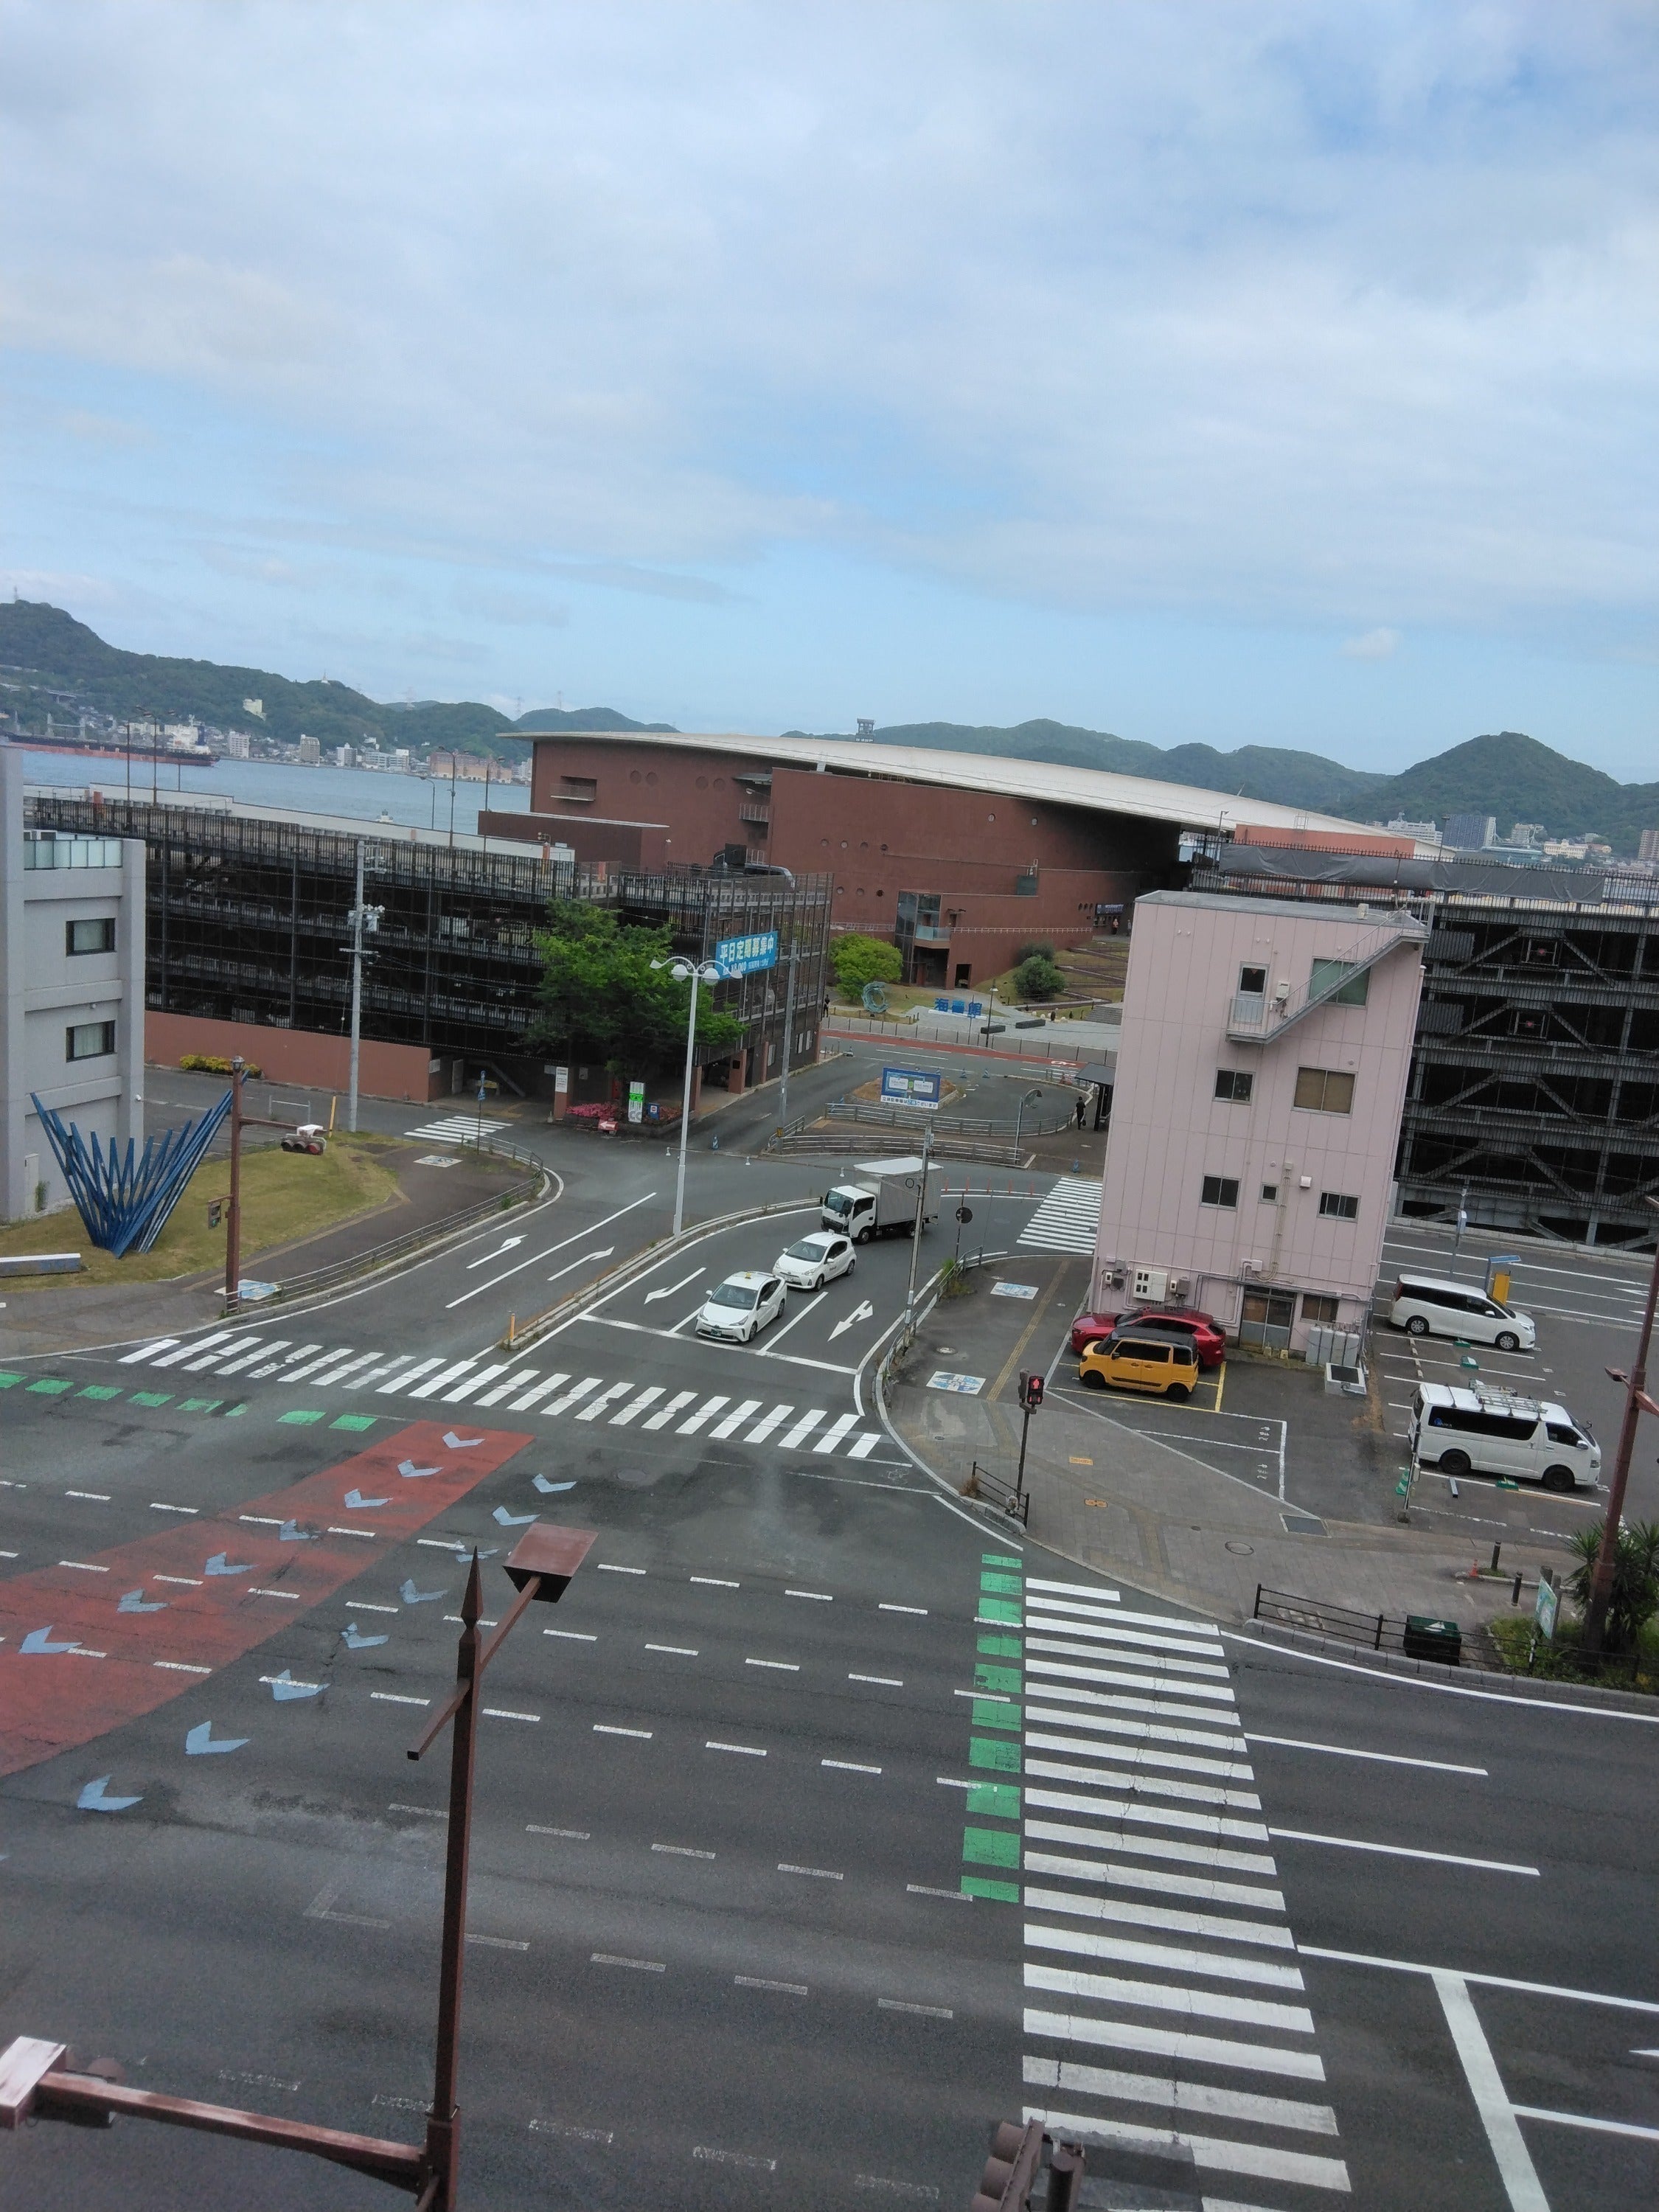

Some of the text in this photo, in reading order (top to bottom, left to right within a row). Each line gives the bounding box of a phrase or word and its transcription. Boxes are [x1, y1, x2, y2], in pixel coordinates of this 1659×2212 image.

[720, 934, 774, 965] 平日定期募集中
